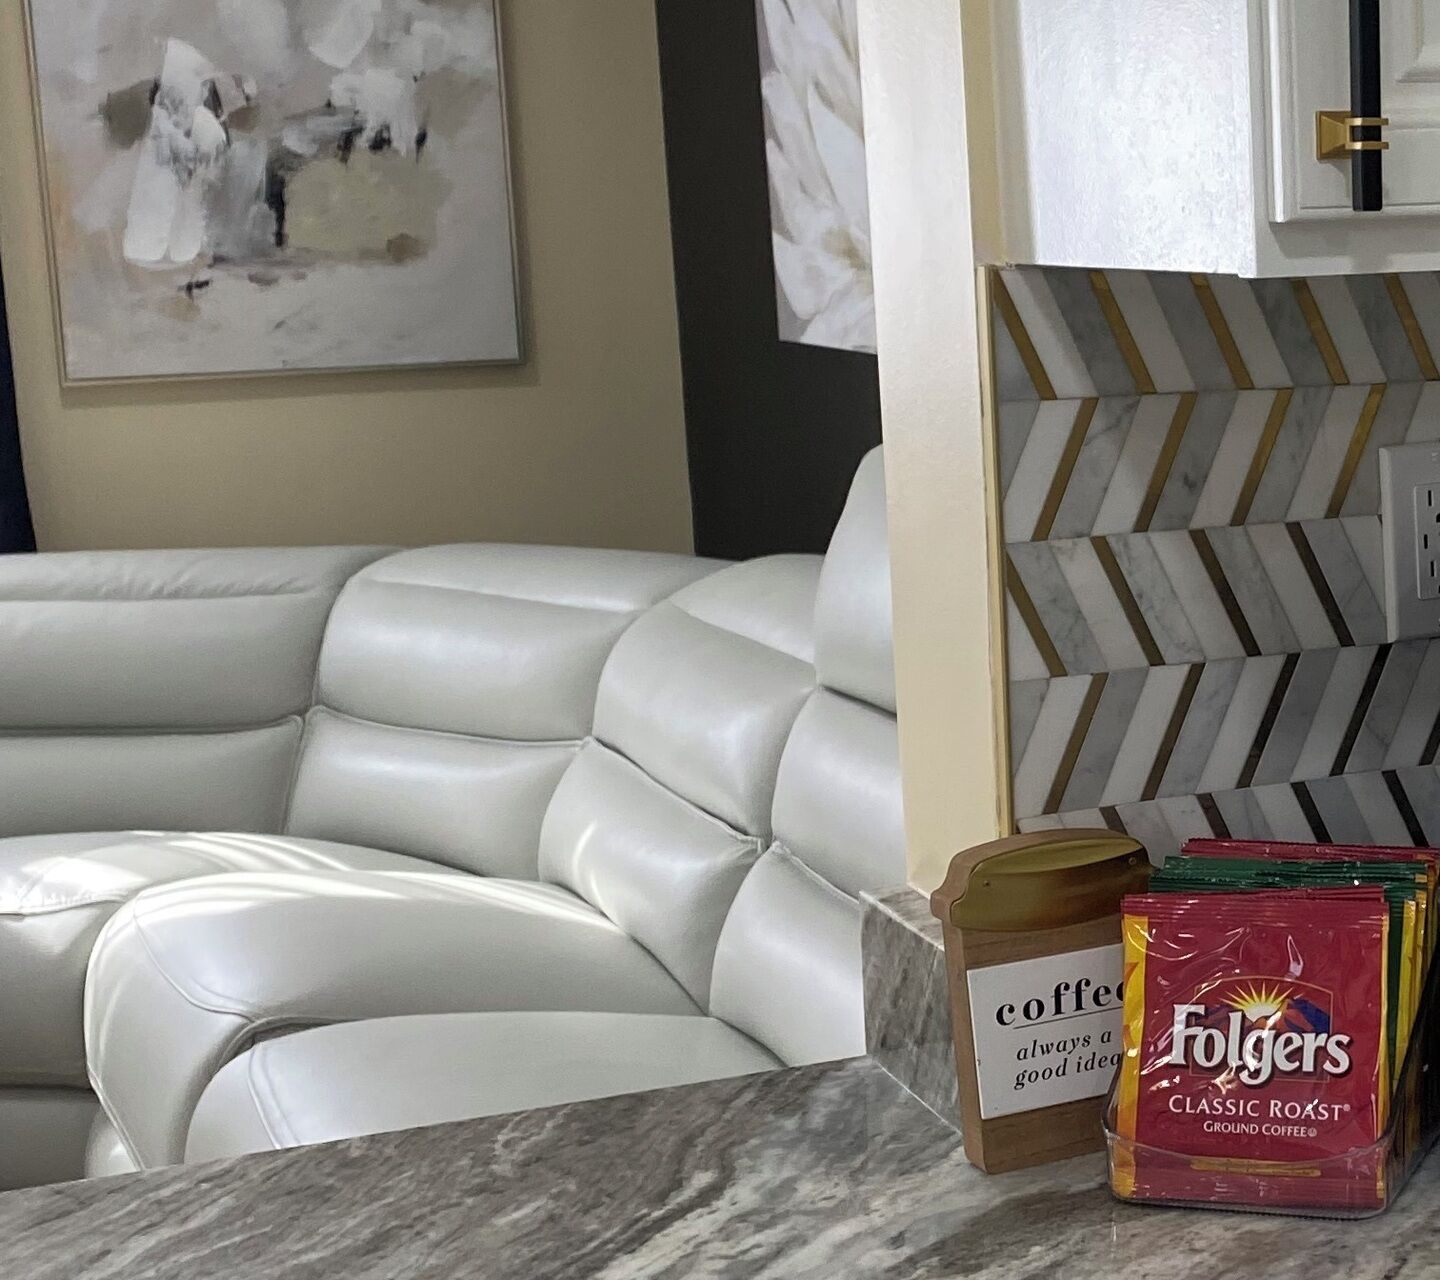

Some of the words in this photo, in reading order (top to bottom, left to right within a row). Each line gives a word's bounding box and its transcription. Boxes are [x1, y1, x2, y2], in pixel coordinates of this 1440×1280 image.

[1016, 1034, 1092, 1061] always
[1100, 1029, 1112, 1044] a
[1168, 1004, 1352, 1086] Folgers
[1013, 1057, 1068, 1091] good
[1076, 1051, 1122, 1073] idea
[1168, 1094, 1260, 1118] CLASSIC
[1203, 1120, 1259, 1135] GROUND
[1262, 1123, 1308, 1138] COFFEE
